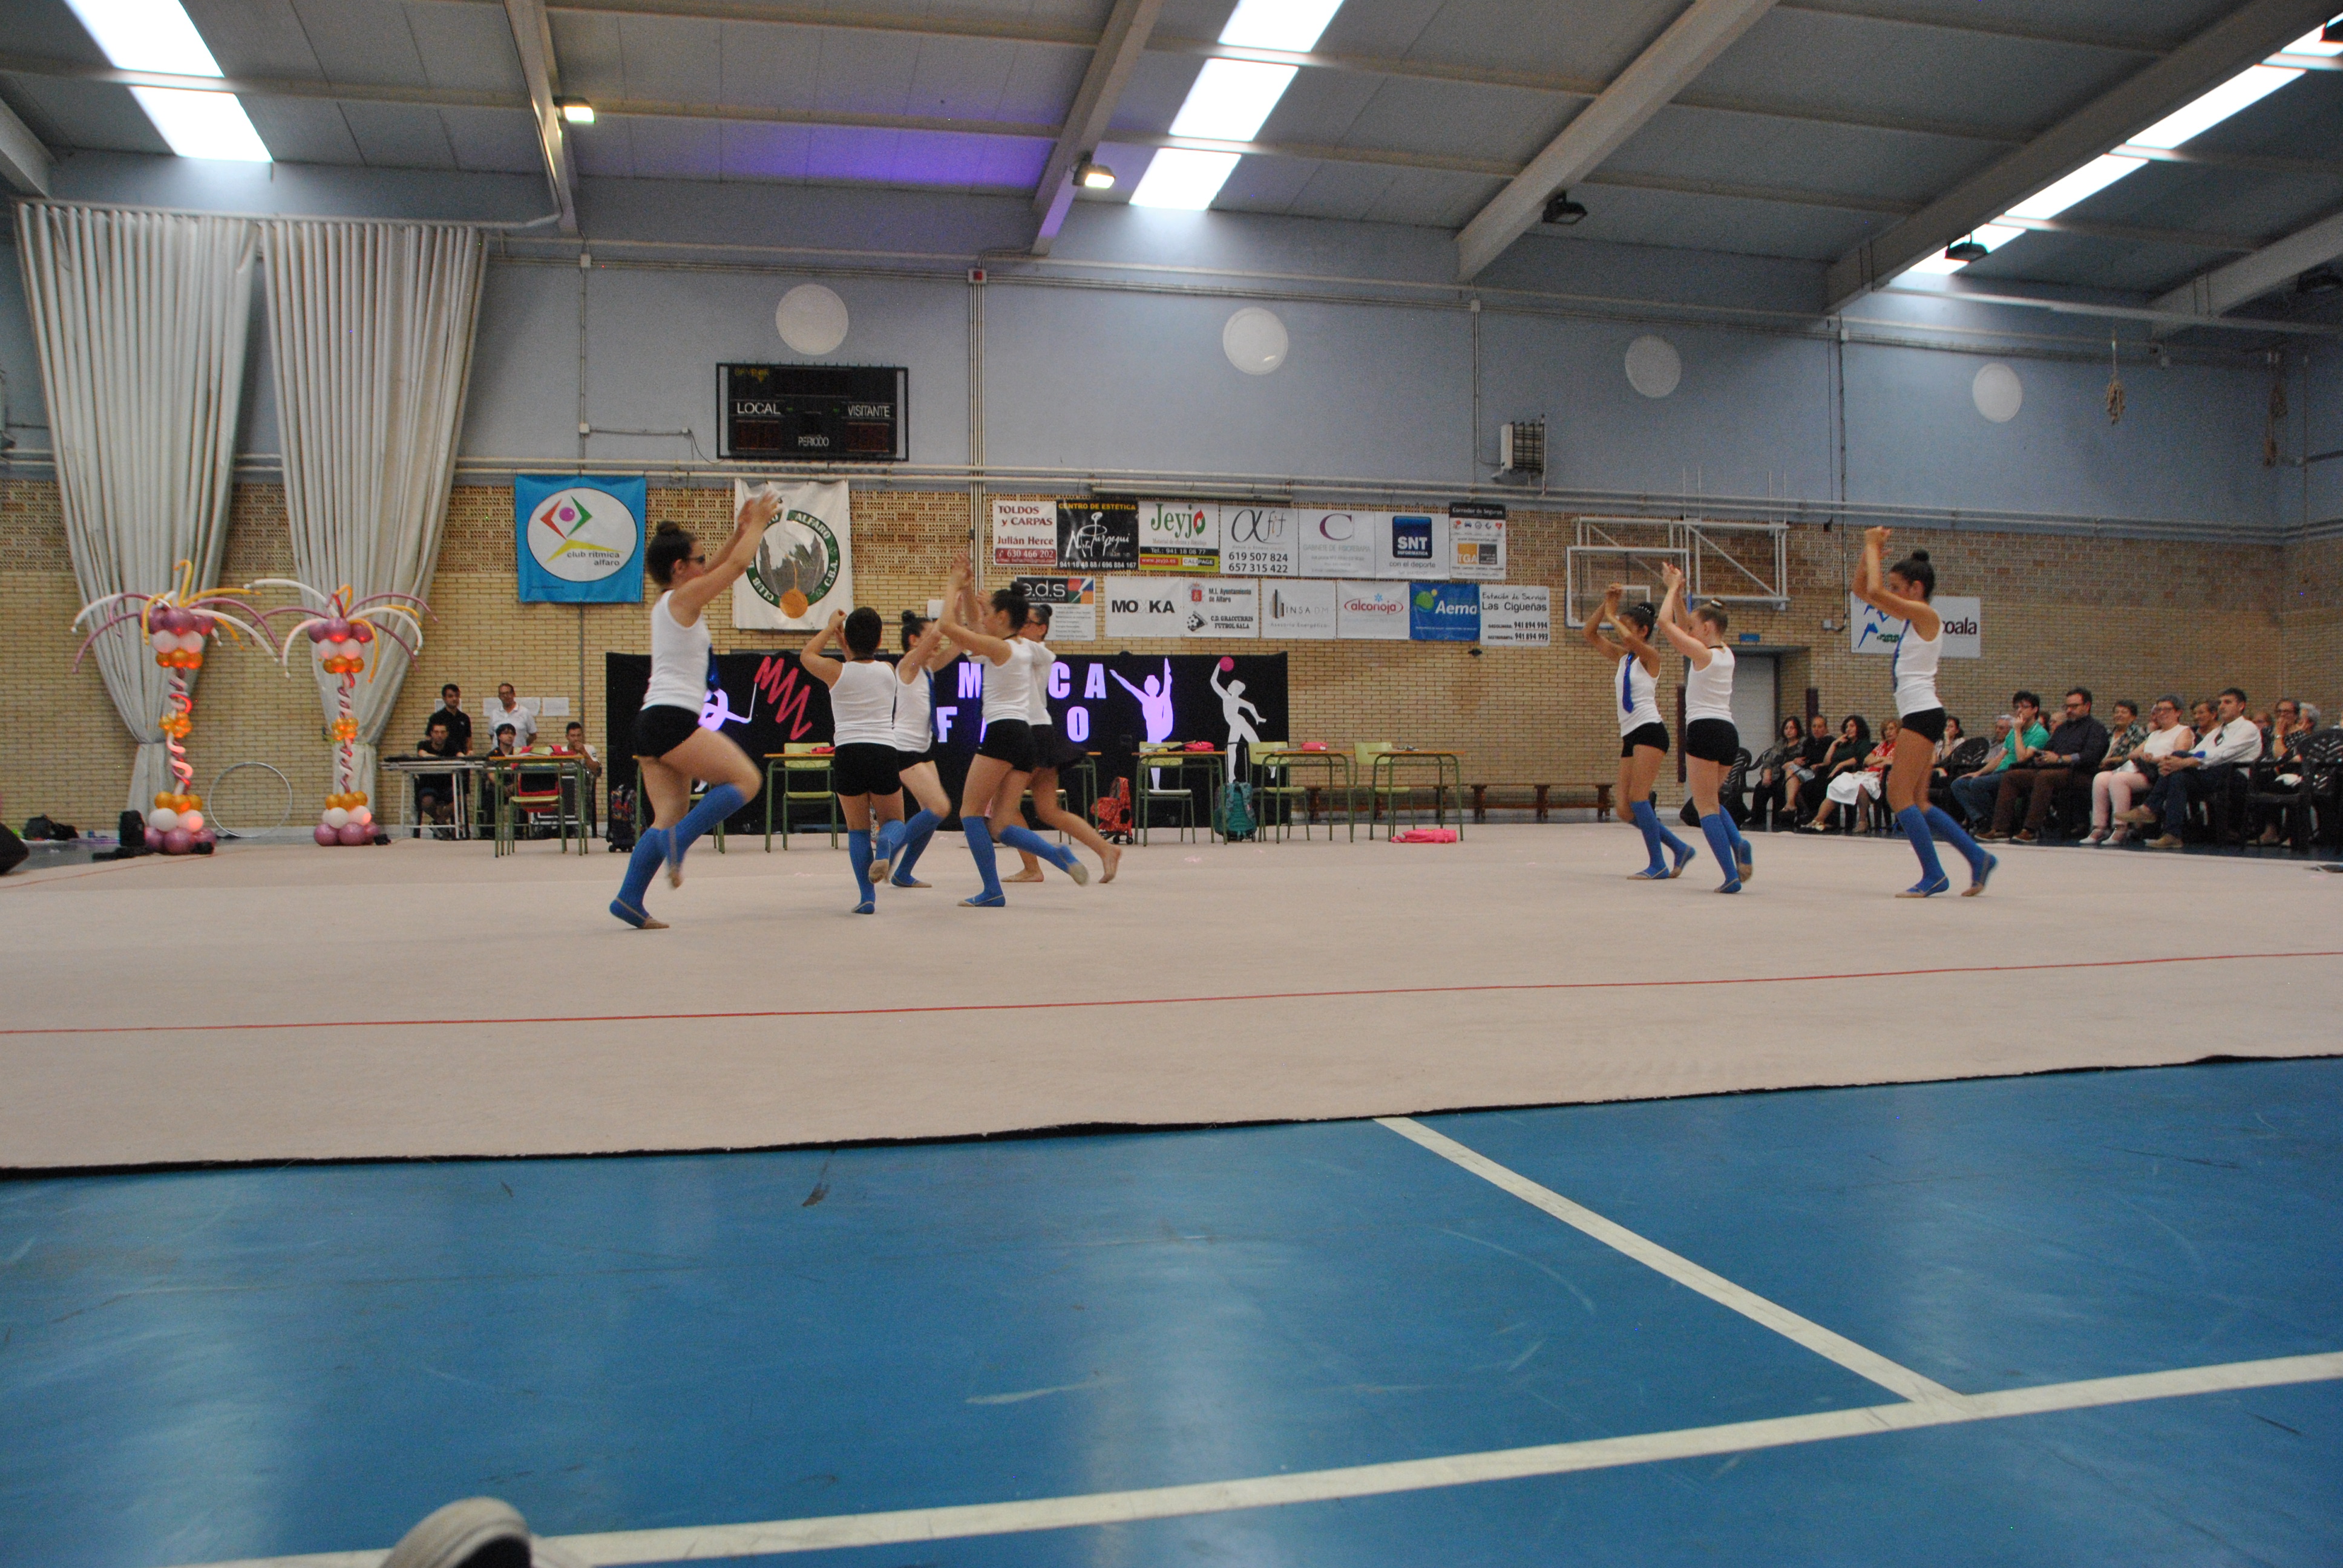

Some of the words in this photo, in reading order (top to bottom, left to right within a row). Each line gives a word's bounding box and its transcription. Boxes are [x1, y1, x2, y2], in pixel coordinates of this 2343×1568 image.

[736, 402, 781, 415] LOCAL
[848, 405, 890, 417] VISITANTE
[798, 435, 829, 447] PERIODO
[998, 505, 1040, 514] TOLDOS
[795, 512, 831, 540] ALFARO
[1001, 518, 1008, 527] y
[1011, 517, 1053, 526] CARPAS
[1151, 503, 1206, 539] Jeyjo
[1319, 513, 1352, 541] C
[1027, 535, 1054, 545] Herce
[1397, 536, 1427, 550] SNT
[1007, 549, 1021, 557] 630
[1023, 549, 1038, 558] 466
[1228, 551, 1247, 561] 619
[1250, 552, 1267, 561] 507
[1270, 553, 1288, 562] 824
[1458, 554, 1478, 563] TGA
[824, 560, 839, 587] C.B.A.
[1228, 563, 1247, 572] 657
[1250, 563, 1268, 572] 315
[1270, 564, 1288, 573] 422
[752, 577, 775, 602] CLUB
[1219, 587, 1252, 596] Ayuntamiento
[1435, 600, 1478, 615] Aema
[1482, 601, 1499, 610] Las
[1504, 601, 1547, 613] Cigüeñas
[1942, 616, 1978, 635] oala
